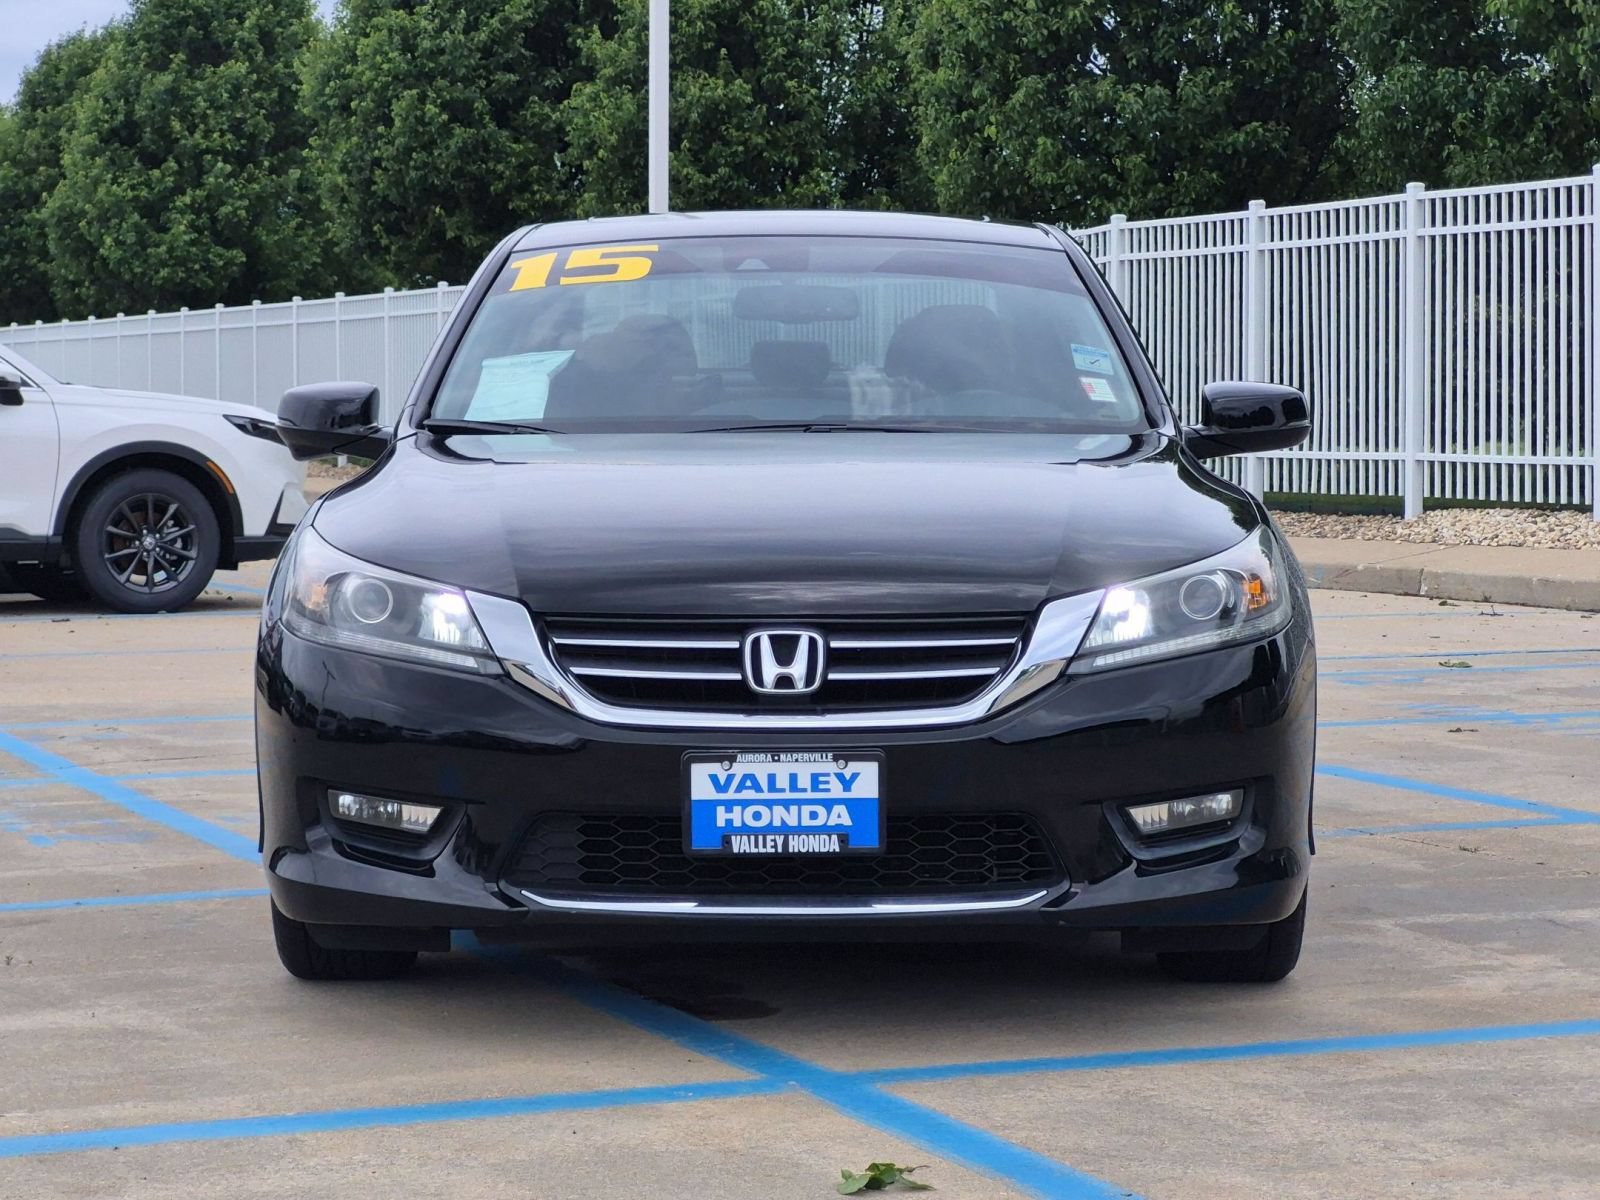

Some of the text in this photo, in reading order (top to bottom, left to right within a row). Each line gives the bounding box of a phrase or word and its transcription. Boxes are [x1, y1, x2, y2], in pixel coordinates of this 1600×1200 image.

[509, 244, 659, 291] 15
[736, 753, 834, 763] AURORA NAPERVILLE
[708, 772, 861, 794] VALLEY
[716, 804, 853, 827] HONDA
[731, 834, 840, 853] VALLEY HONDA
